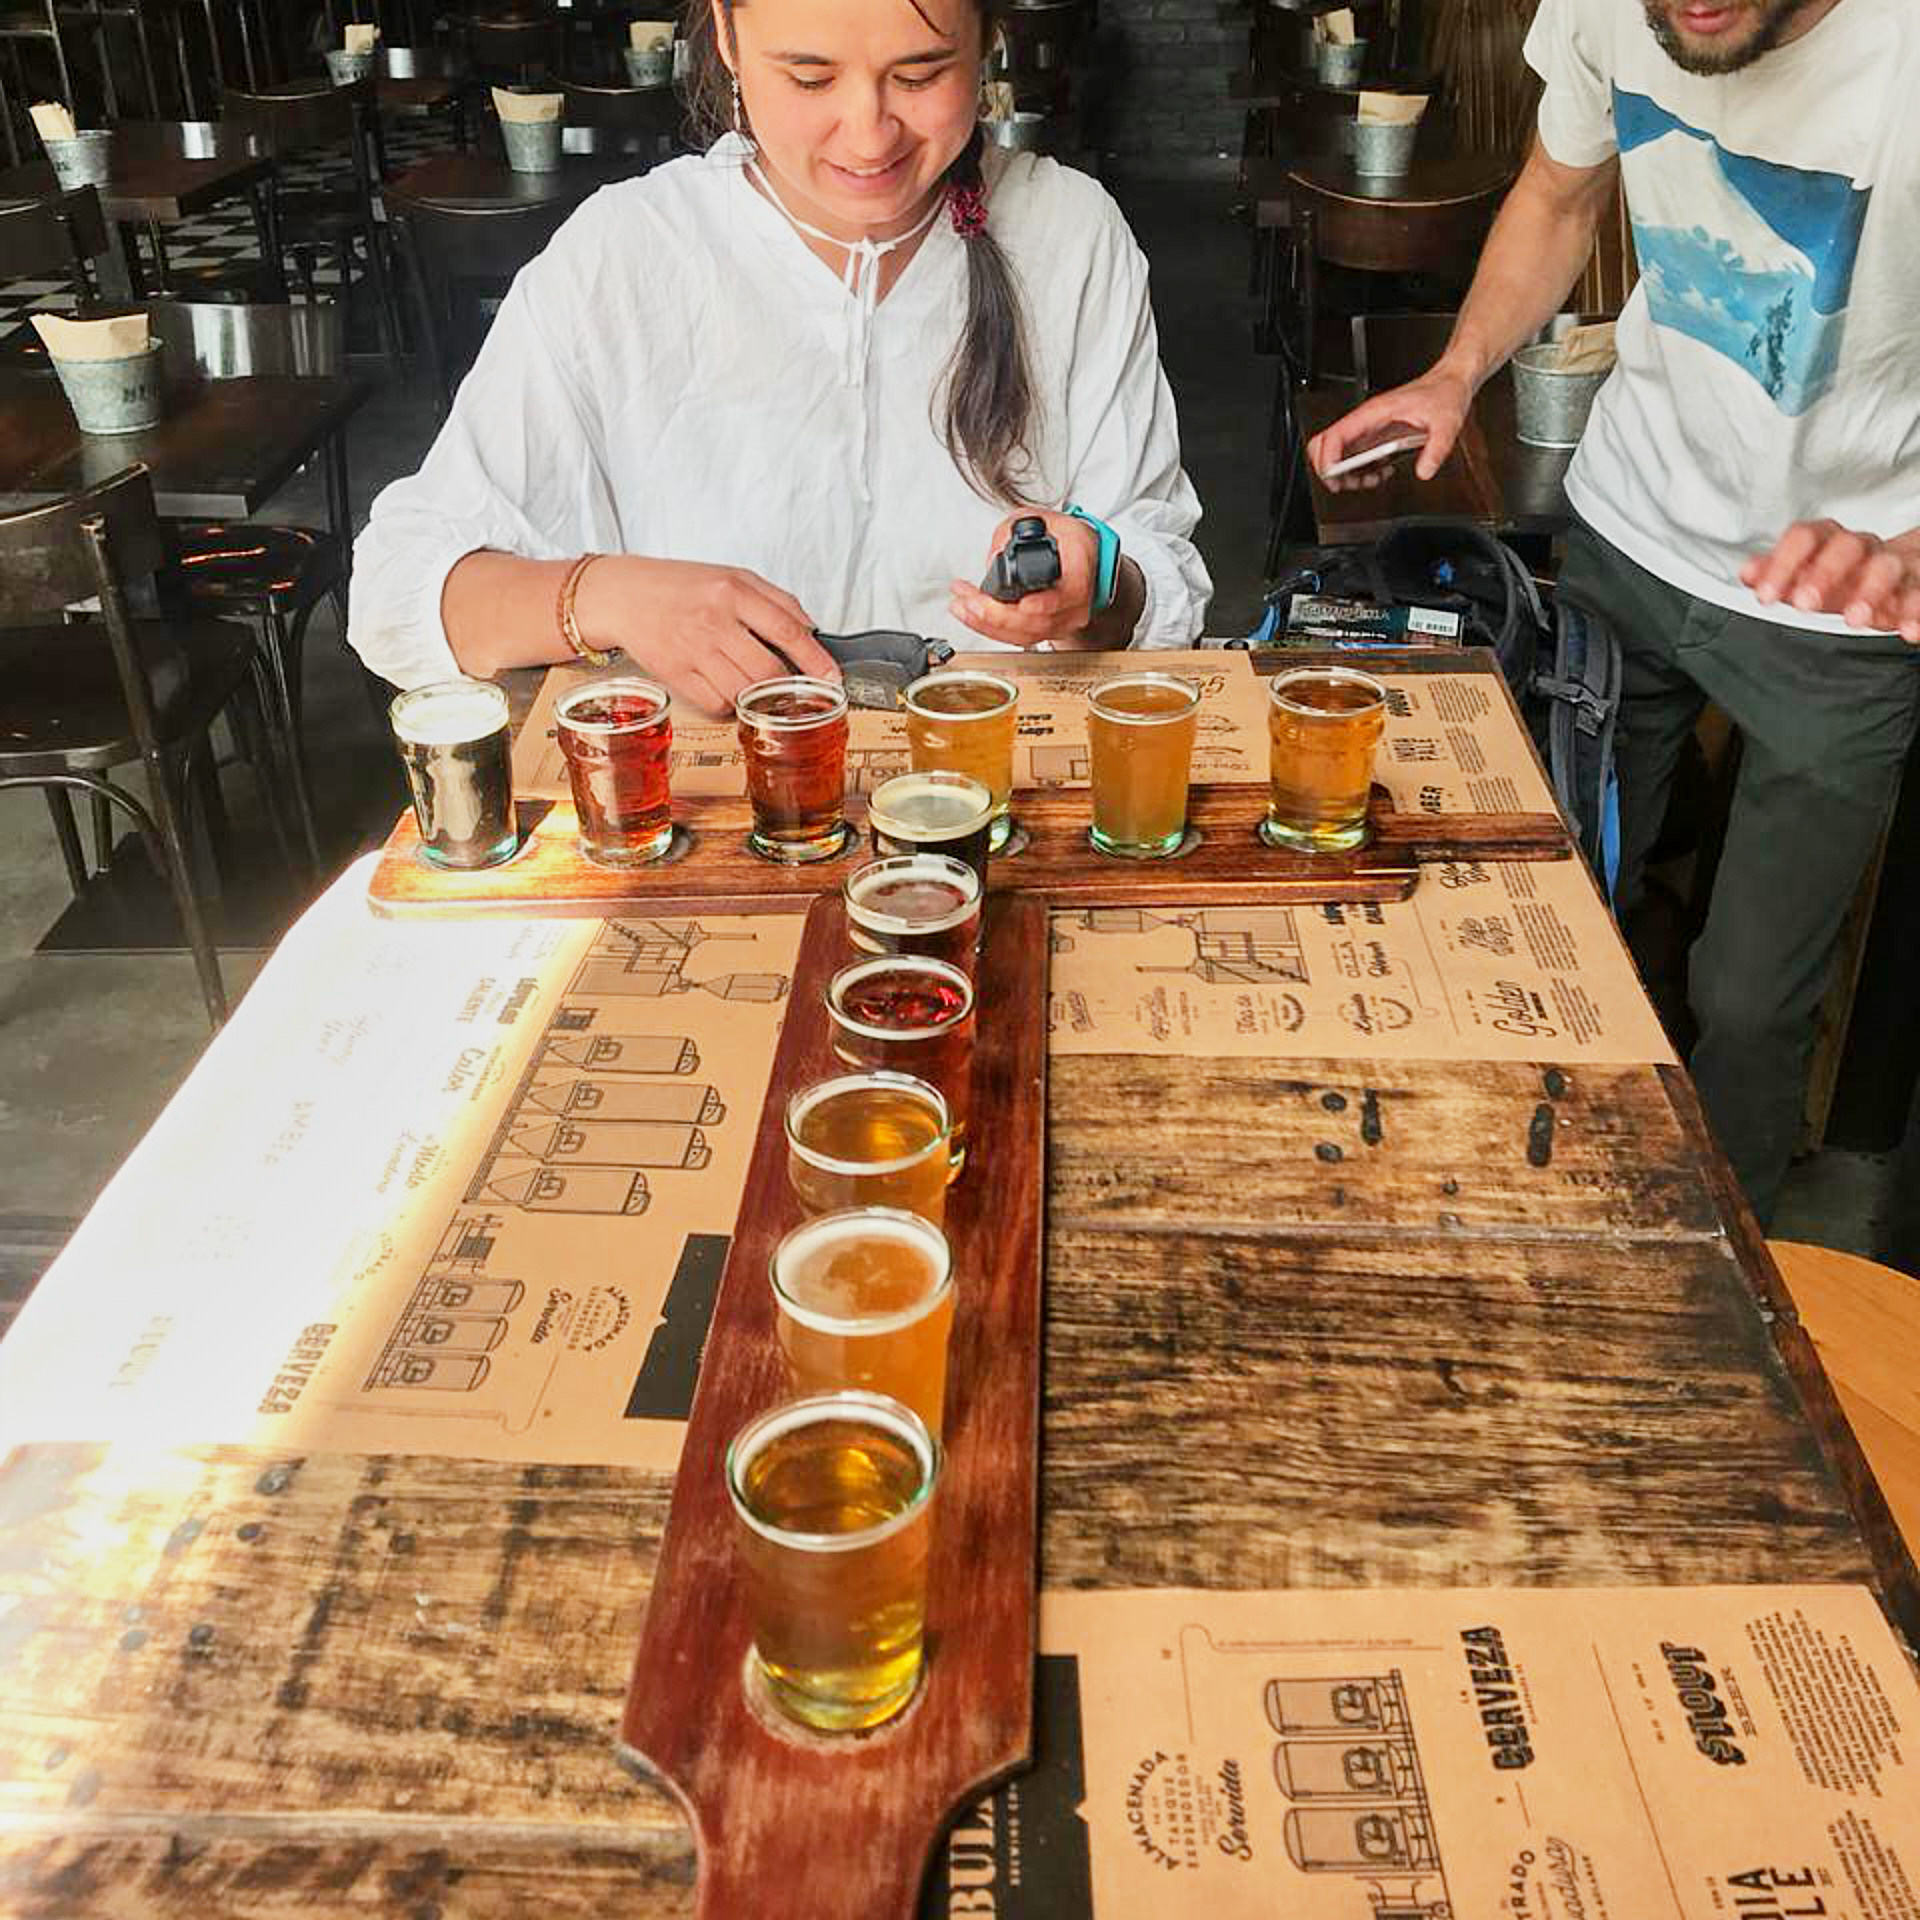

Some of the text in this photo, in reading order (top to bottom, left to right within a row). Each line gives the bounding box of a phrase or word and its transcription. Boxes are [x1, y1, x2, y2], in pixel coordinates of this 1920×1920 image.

[1492, 980, 1556, 1038] Golden
[257, 1322, 338, 1416] CERVEZA
[1460, 1625, 1535, 1771] CERVEZA
[1658, 1641, 1747, 1766] STOUT
[1008, 1818, 1021, 1887] BREWING
[1126, 1749, 1180, 1871] ALMACENADA
[1167, 1775, 1181, 1845] TANQUE
[1216, 1757, 1254, 1862] Servida
